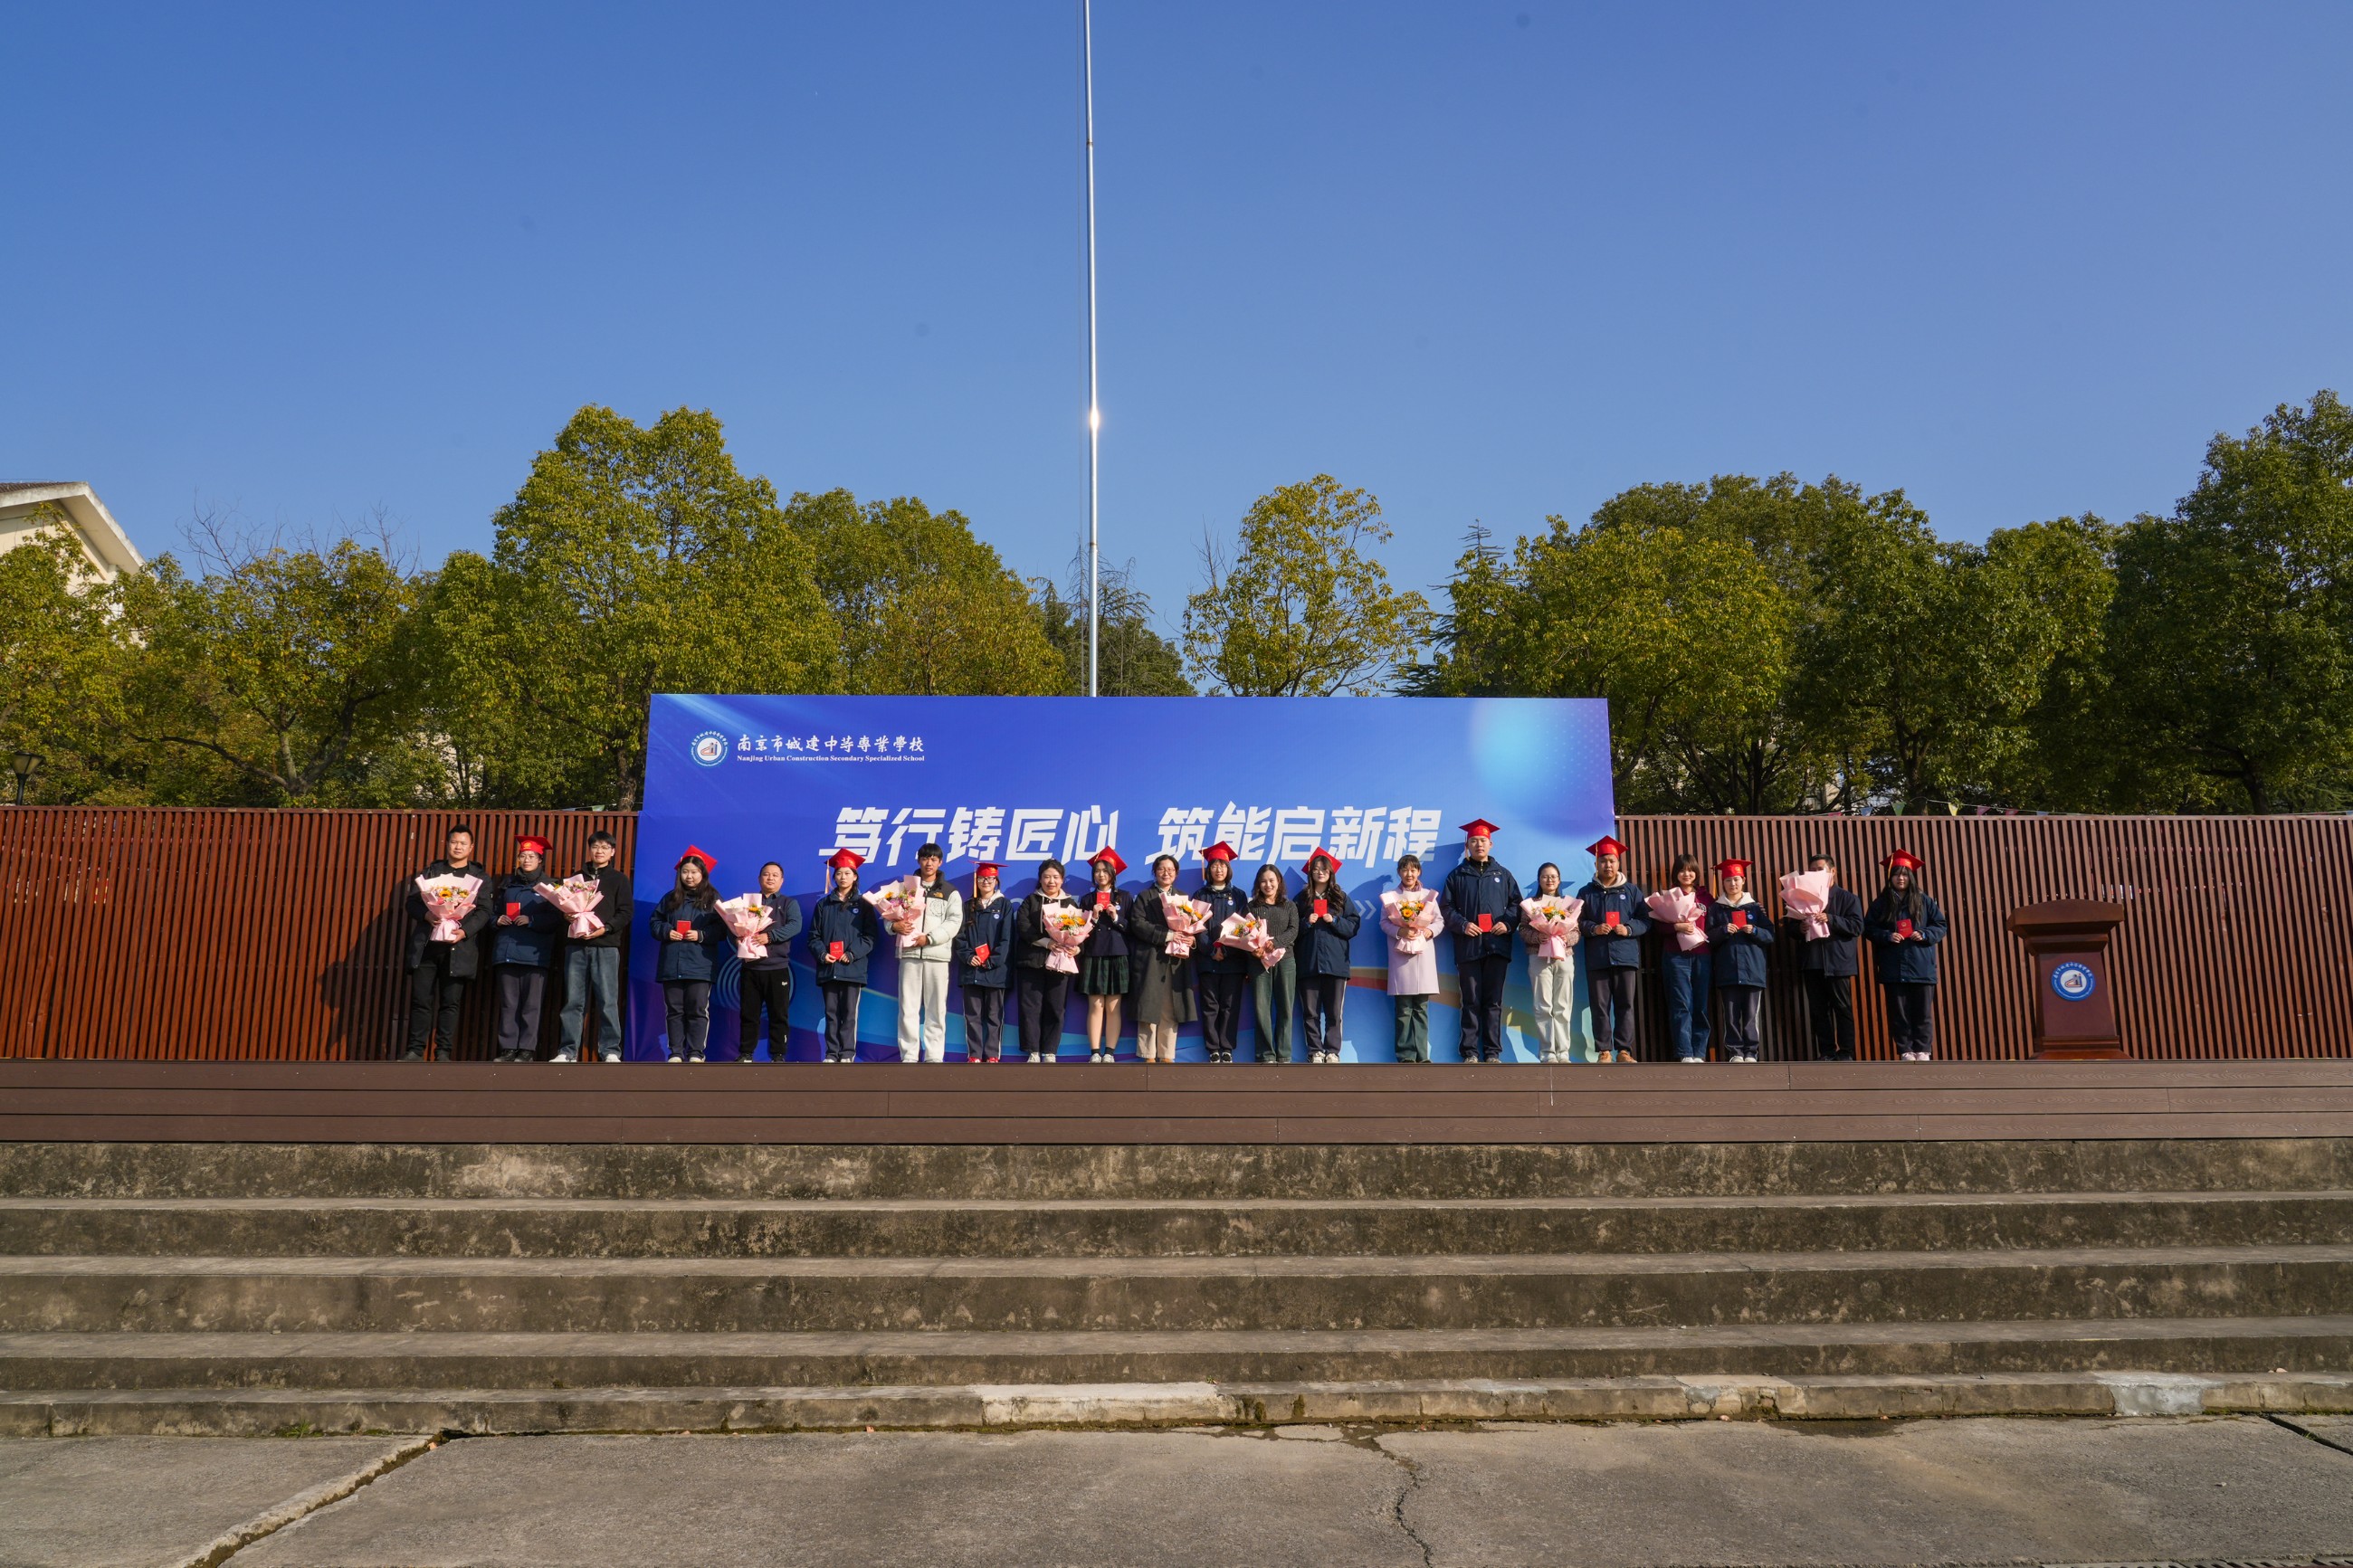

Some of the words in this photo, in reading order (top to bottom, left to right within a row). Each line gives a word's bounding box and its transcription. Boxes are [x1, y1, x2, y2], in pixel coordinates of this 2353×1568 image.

[737, 755, 763, 763] Nanjing
[830, 755, 864, 763] Secondary
[864, 755, 901, 763] Specialized
[818, 804, 1119, 867] 笃行铸匠心
[1145, 801, 1442, 869] 筑能启新程
